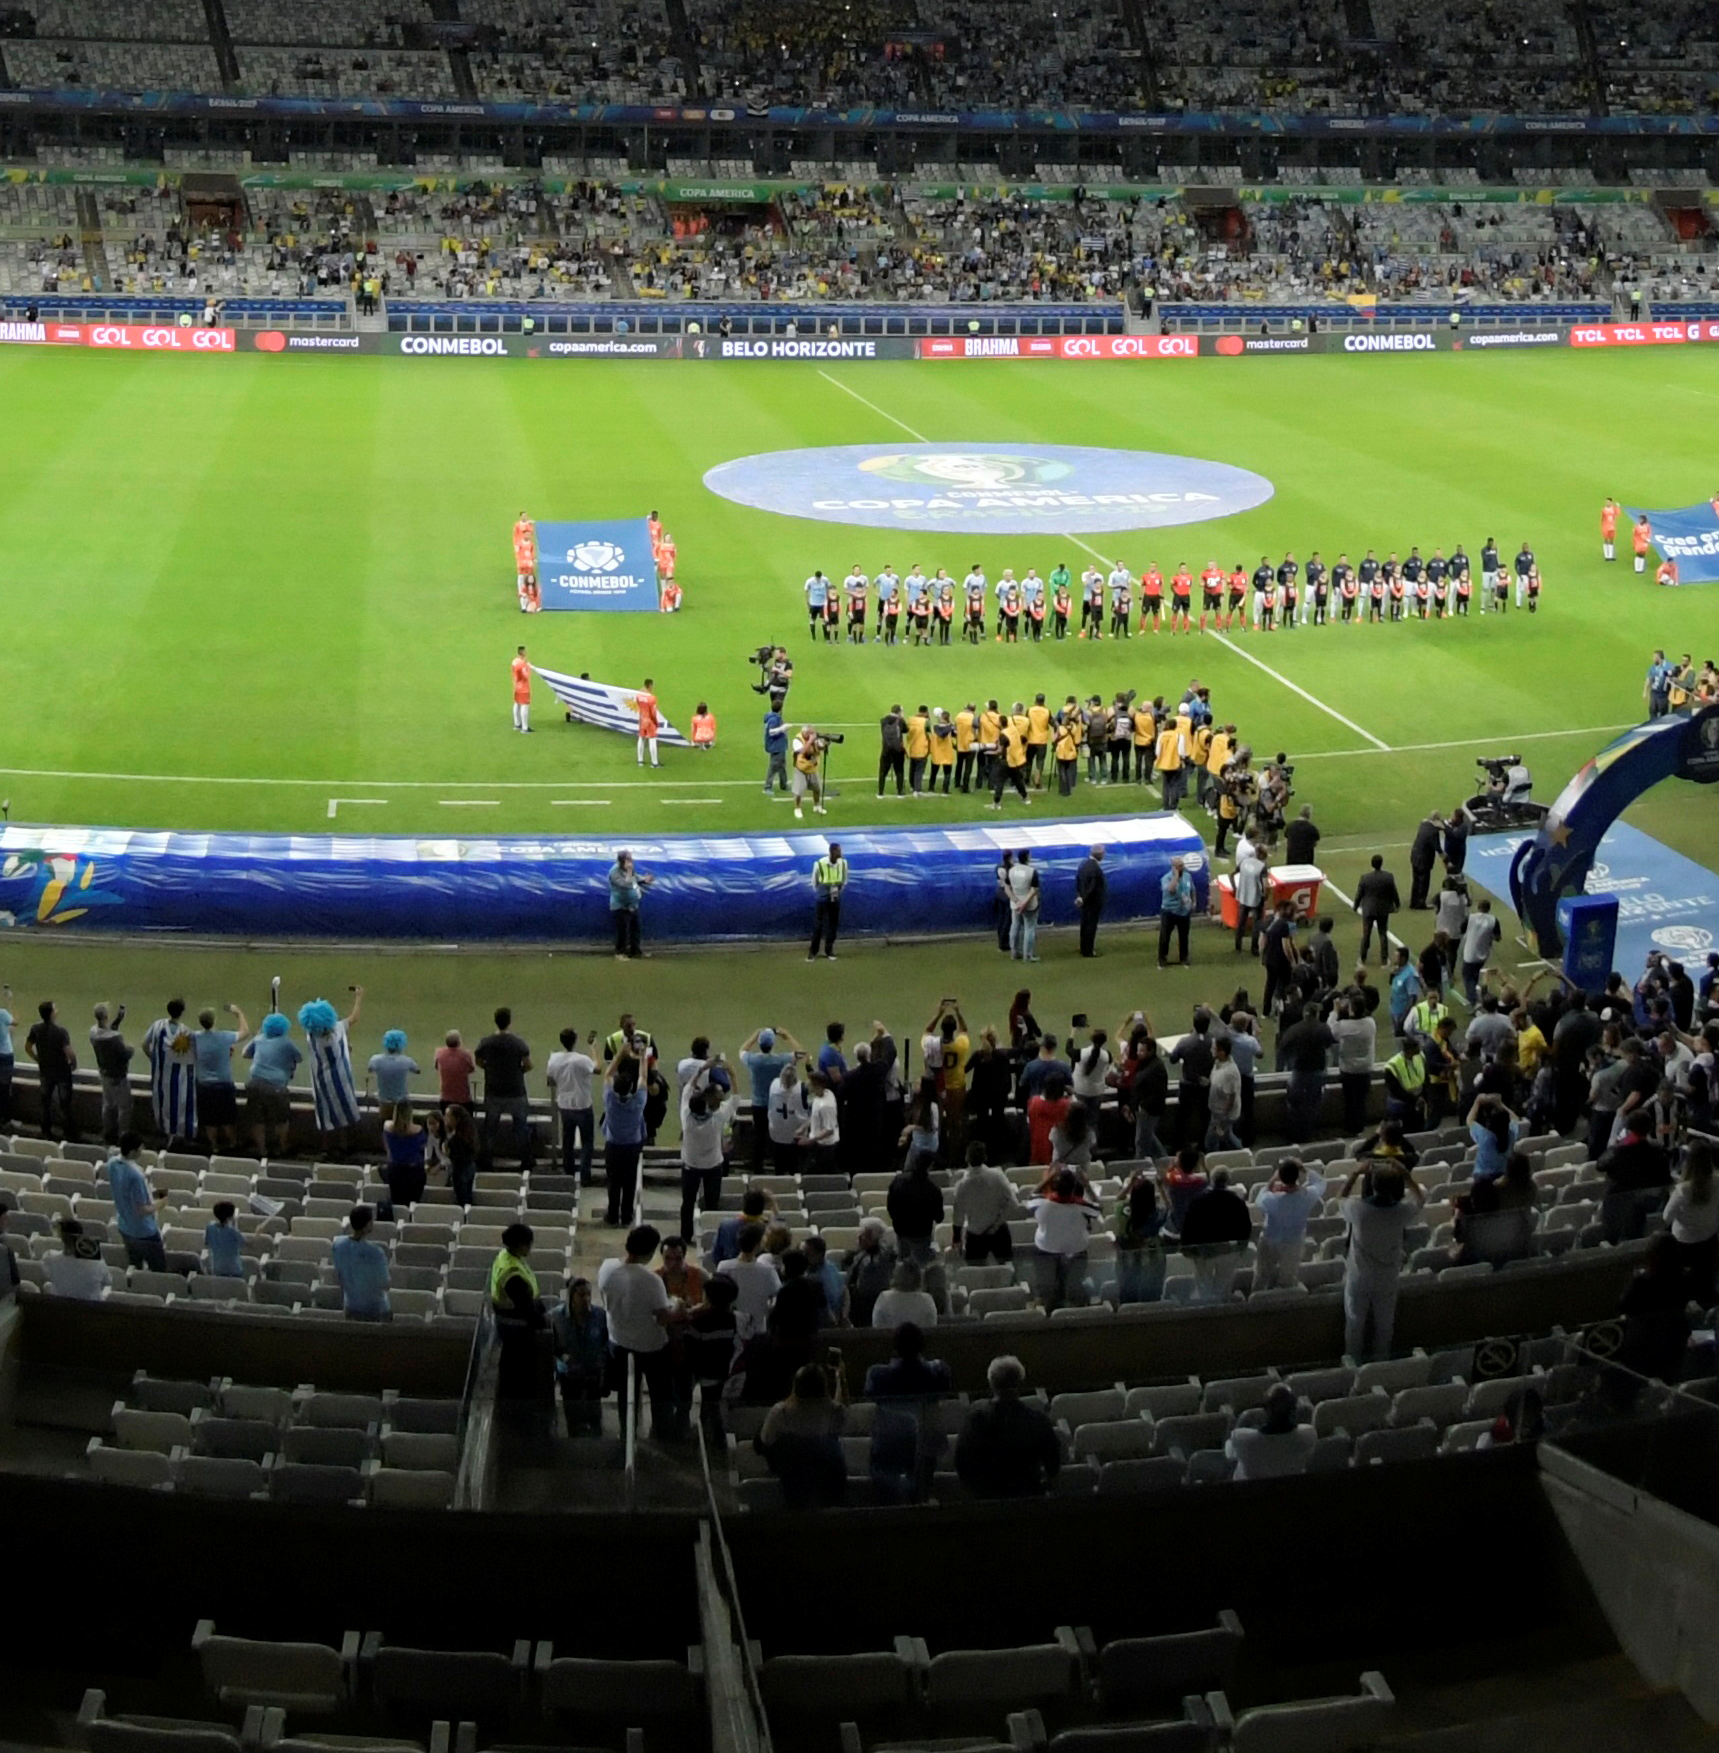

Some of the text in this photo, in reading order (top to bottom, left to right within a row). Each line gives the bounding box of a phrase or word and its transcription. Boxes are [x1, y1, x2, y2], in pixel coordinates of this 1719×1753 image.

[421, 105, 485, 115] COPA AMERICA
[896, 114, 960, 124] COPA AMERICA
[679, 188, 755, 199] COPA AMERICA
[92, 327, 131, 345] GOL
[142, 329, 181, 346] GOL
[192, 331, 231, 348] GOL
[1469, 331, 1558, 345] copaamerica.com
[1574, 327, 1683, 342] TCL TCL TCL
[1687, 324, 1700, 339] G
[289, 336, 359, 348] mastercard
[400, 337, 508, 355] CONMEBOL
[549, 341, 657, 355] copaamerica.com
[722, 341, 876, 358] BELO HORIZONTE
[964, 338, 1019, 356] BRAHMA
[1064, 339, 1100, 356] GOL
[1111, 339, 1148, 355] GOL
[1157, 338, 1194, 355] GOL
[1246, 338, 1308, 350] mastercard
[1344, 334, 1436, 351] CONMEBOL
[812, 491, 1222, 511] COPA AMERICA
[1654, 534, 1698, 546] Cree
[559, 575, 639, 589] CONMEBOL
[1290, 887, 1312, 910] G
